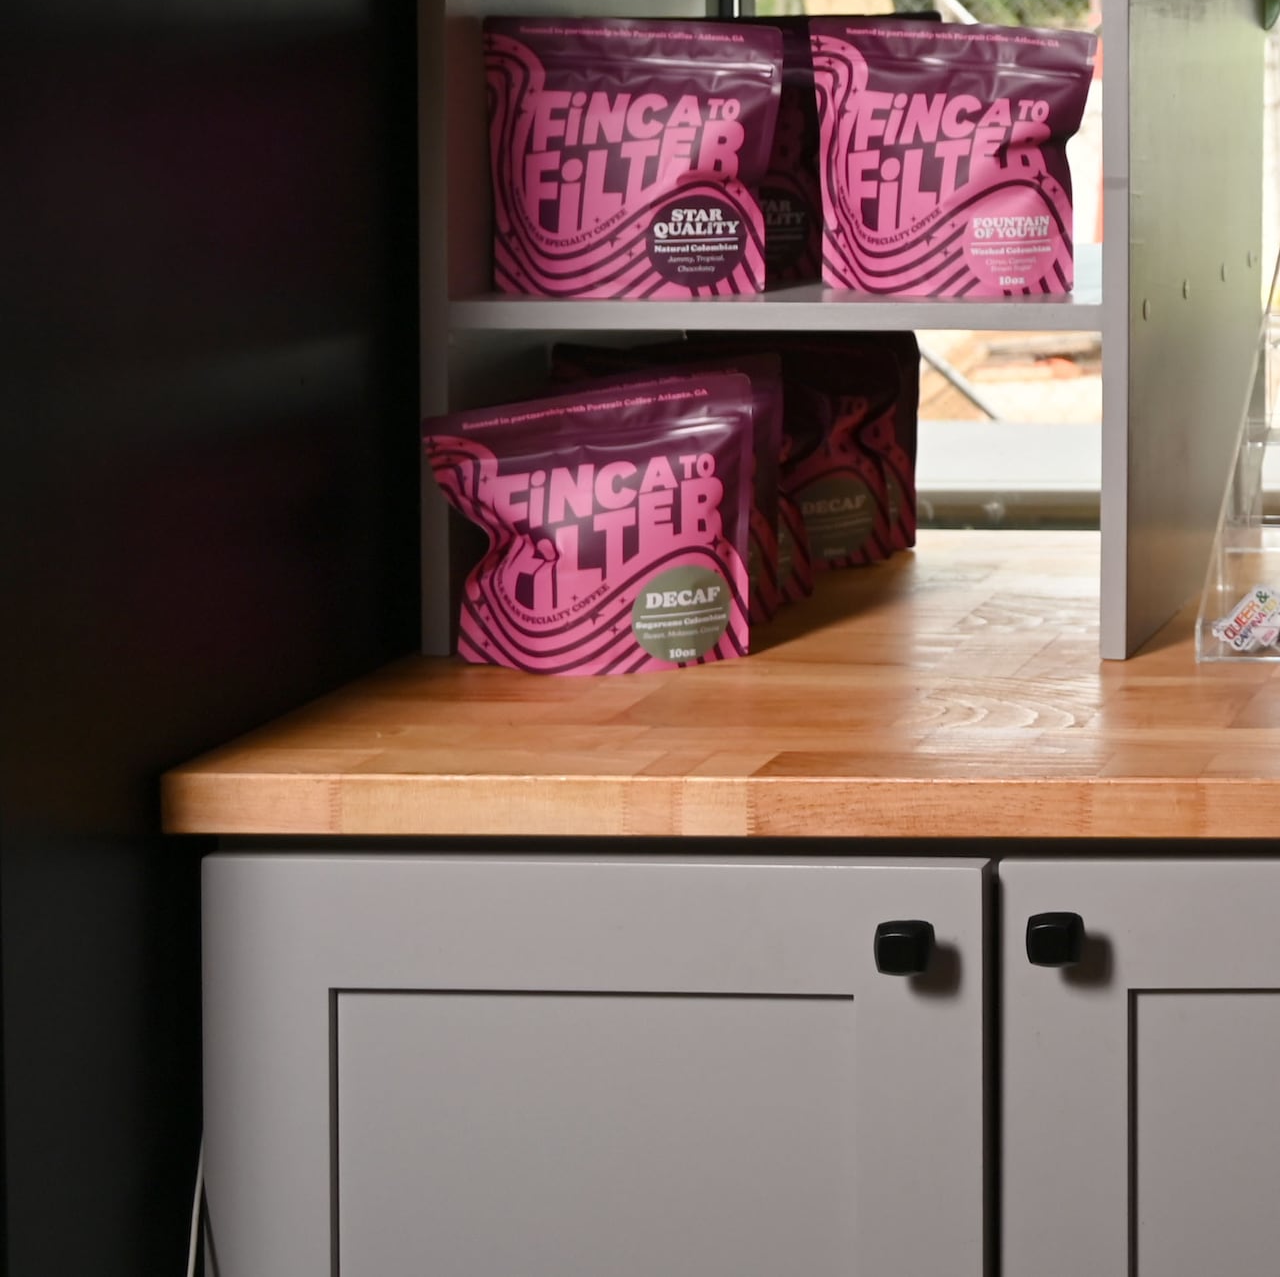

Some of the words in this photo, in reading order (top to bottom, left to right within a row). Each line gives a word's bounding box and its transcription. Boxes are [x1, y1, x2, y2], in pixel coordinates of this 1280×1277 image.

[668, 32, 693, 41] Coffee
[732, 34, 745, 42] GA
[708, 98, 741, 120] TO
[1018, 99, 1050, 121] TO
[671, 208, 723, 222] STAR
[546, 232, 594, 248] SPECIALTY
[594, 208, 627, 236] COFFEE
[867, 229, 911, 247] SPECIALTY
[911, 206, 943, 233] COFFEE
[974, 226, 995, 239] OF
[996, 224, 1048, 238] YOUTH
[653, 244, 690, 253] Natural
[691, 242, 739, 253] Colombian
[970, 246, 1005, 256] Washed
[1005, 244, 1052, 255] Colombian
[999, 276, 1026, 286] 10oz
[510, 408, 565, 426] partnership
[565, 404, 586, 414] with
[586, 400, 624, 412] Portrait
[624, 397, 652, 407] Coffee
[694, 388, 708, 397] GA
[678, 452, 716, 480] TO
[801, 494, 867, 516] DECAF
[521, 608, 571, 626] SPECIALTY
[571, 583, 611, 614] COFFEE
[645, 586, 721, 610] DECAF
[683, 613, 727, 626] Colombian
[1223, 600, 1262, 640] QUEER
[1255, 590, 1270, 604] &
[668, 648, 697, 659] 10oz
